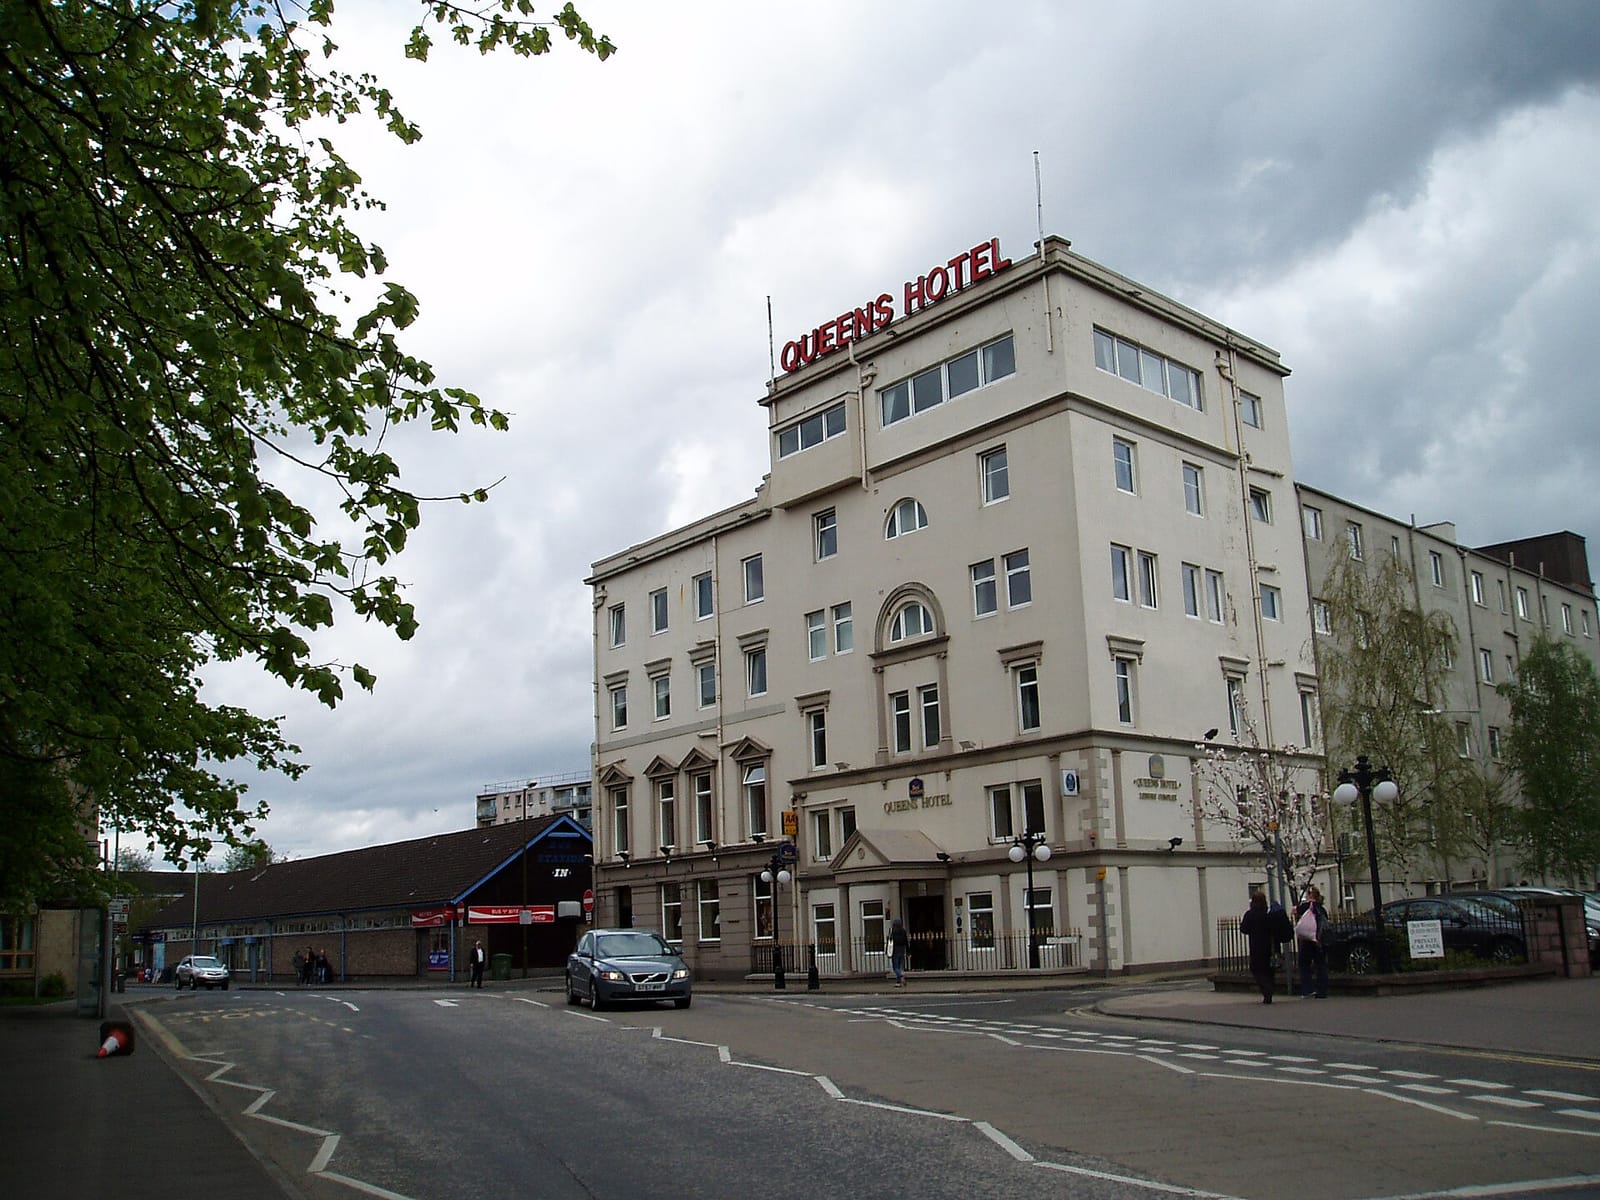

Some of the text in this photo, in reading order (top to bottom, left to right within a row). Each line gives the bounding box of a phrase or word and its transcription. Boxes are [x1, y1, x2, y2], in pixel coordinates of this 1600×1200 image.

[781, 237, 1012, 373] QUEENS HOTEL
[883, 794, 953, 815] QUEENS HOTEL
[553, 868, 570, 878] IN
